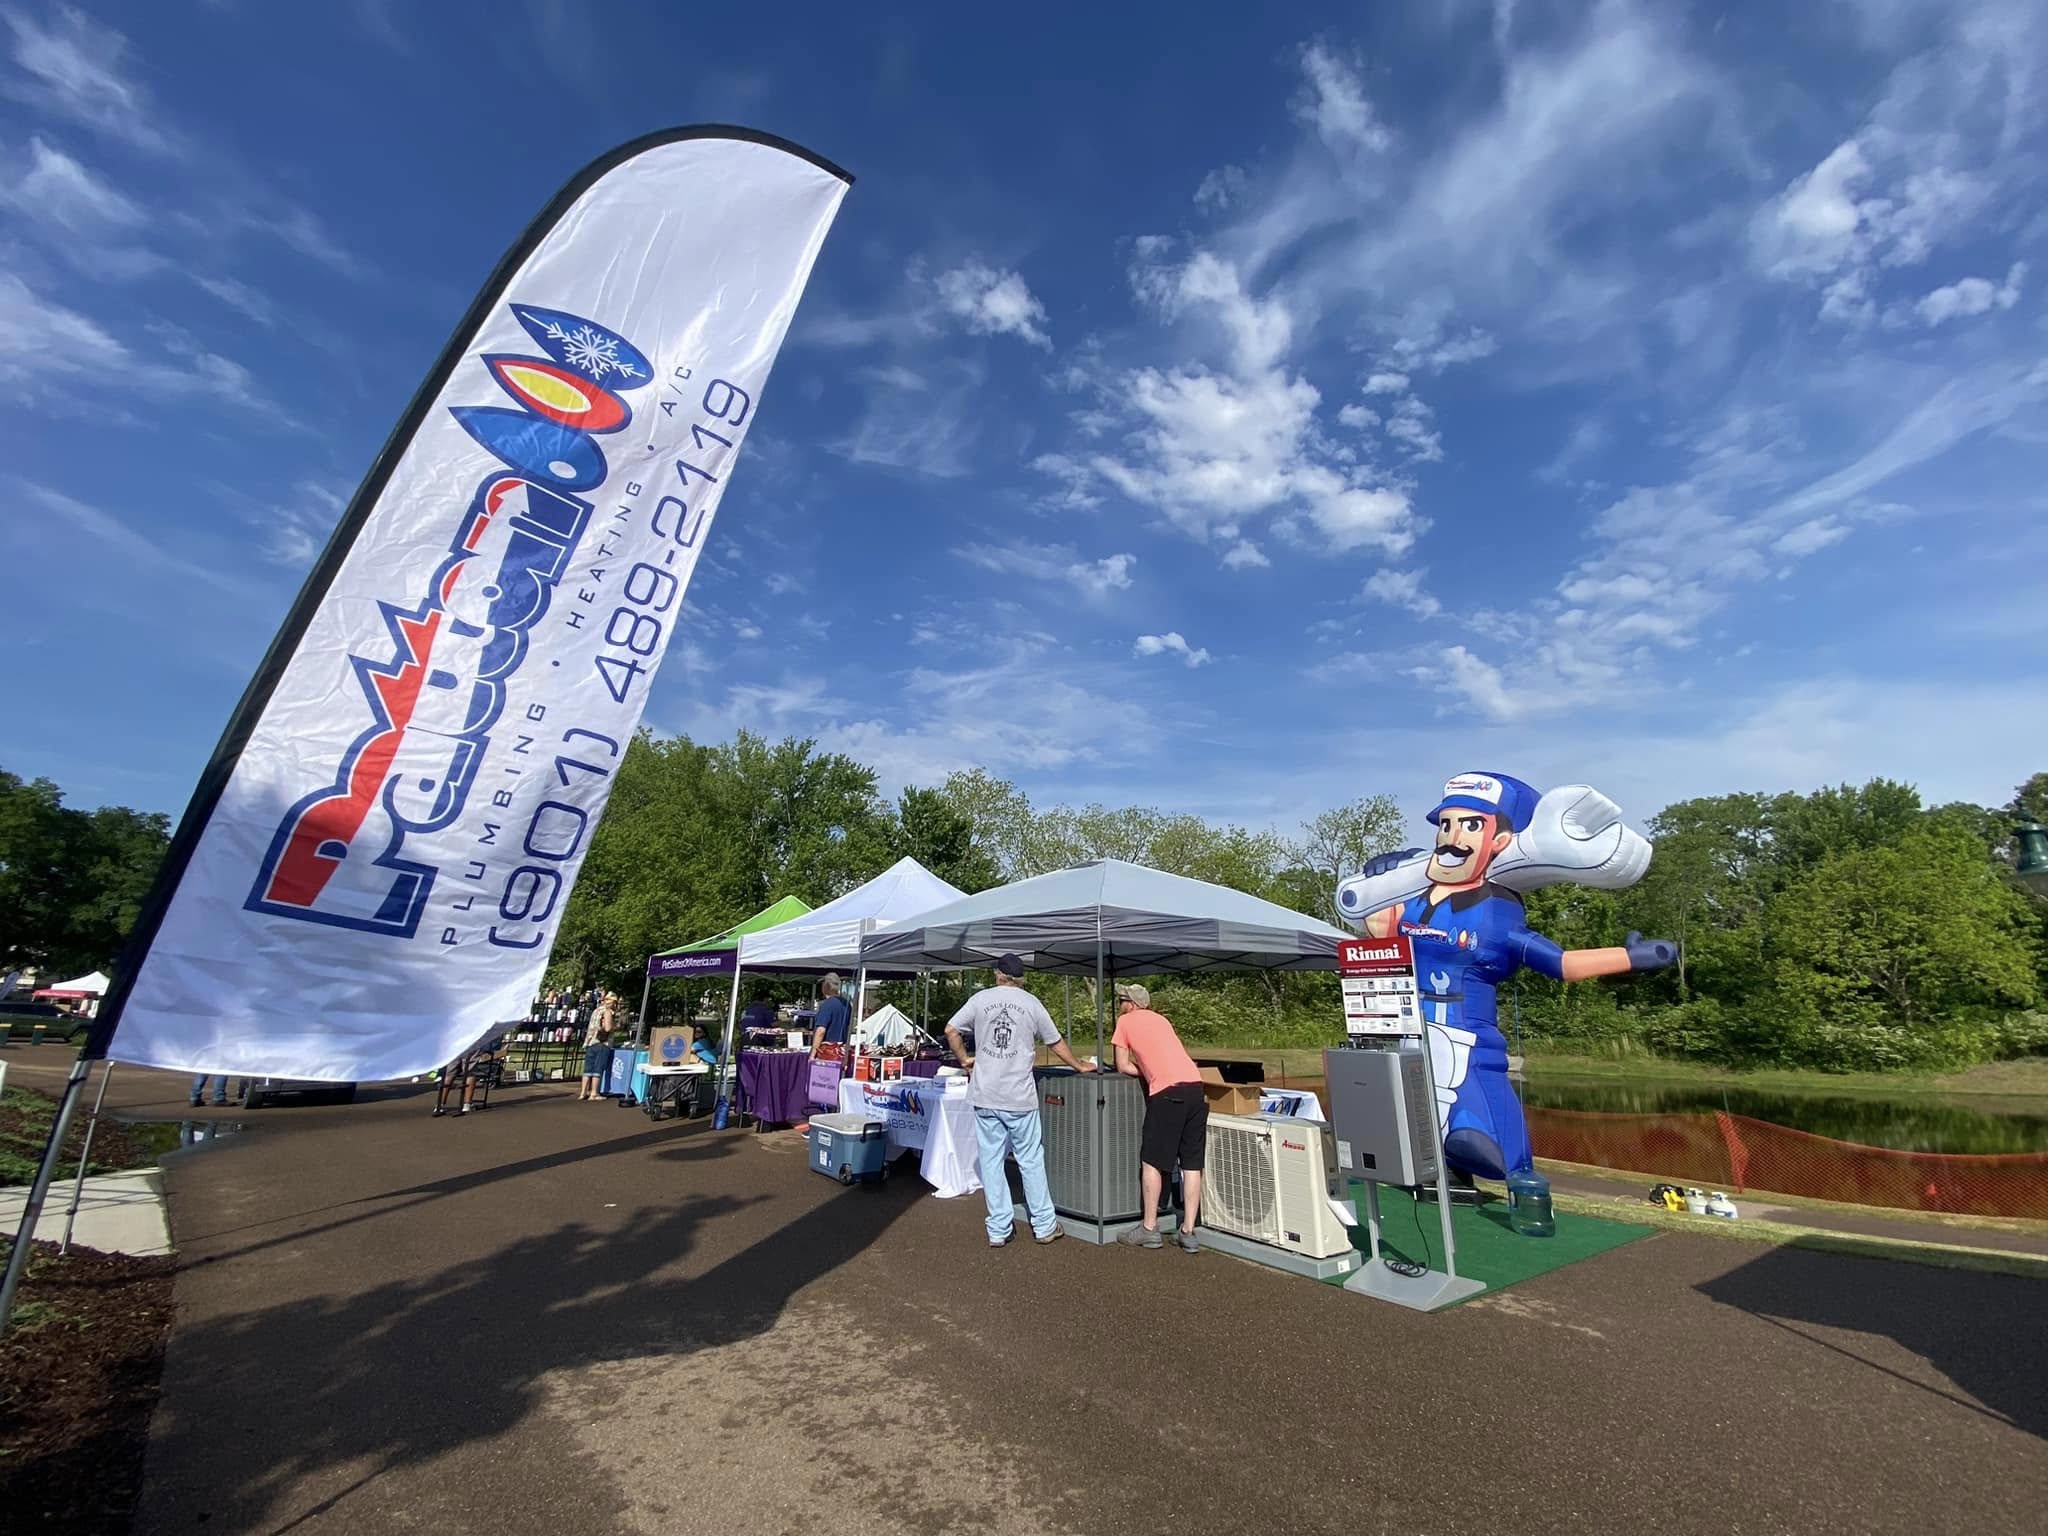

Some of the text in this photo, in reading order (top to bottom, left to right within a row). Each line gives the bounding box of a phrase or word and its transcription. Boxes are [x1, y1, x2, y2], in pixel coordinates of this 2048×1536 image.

[243, 468, 596, 940] Patton
[441, 364, 693, 946] PLUMBING HEATING A/C
[488, 377, 750, 949] (901) 489-2119
[1282, 1140, 1306, 1151] Amana
[1345, 944, 1401, 962] Rinnai
